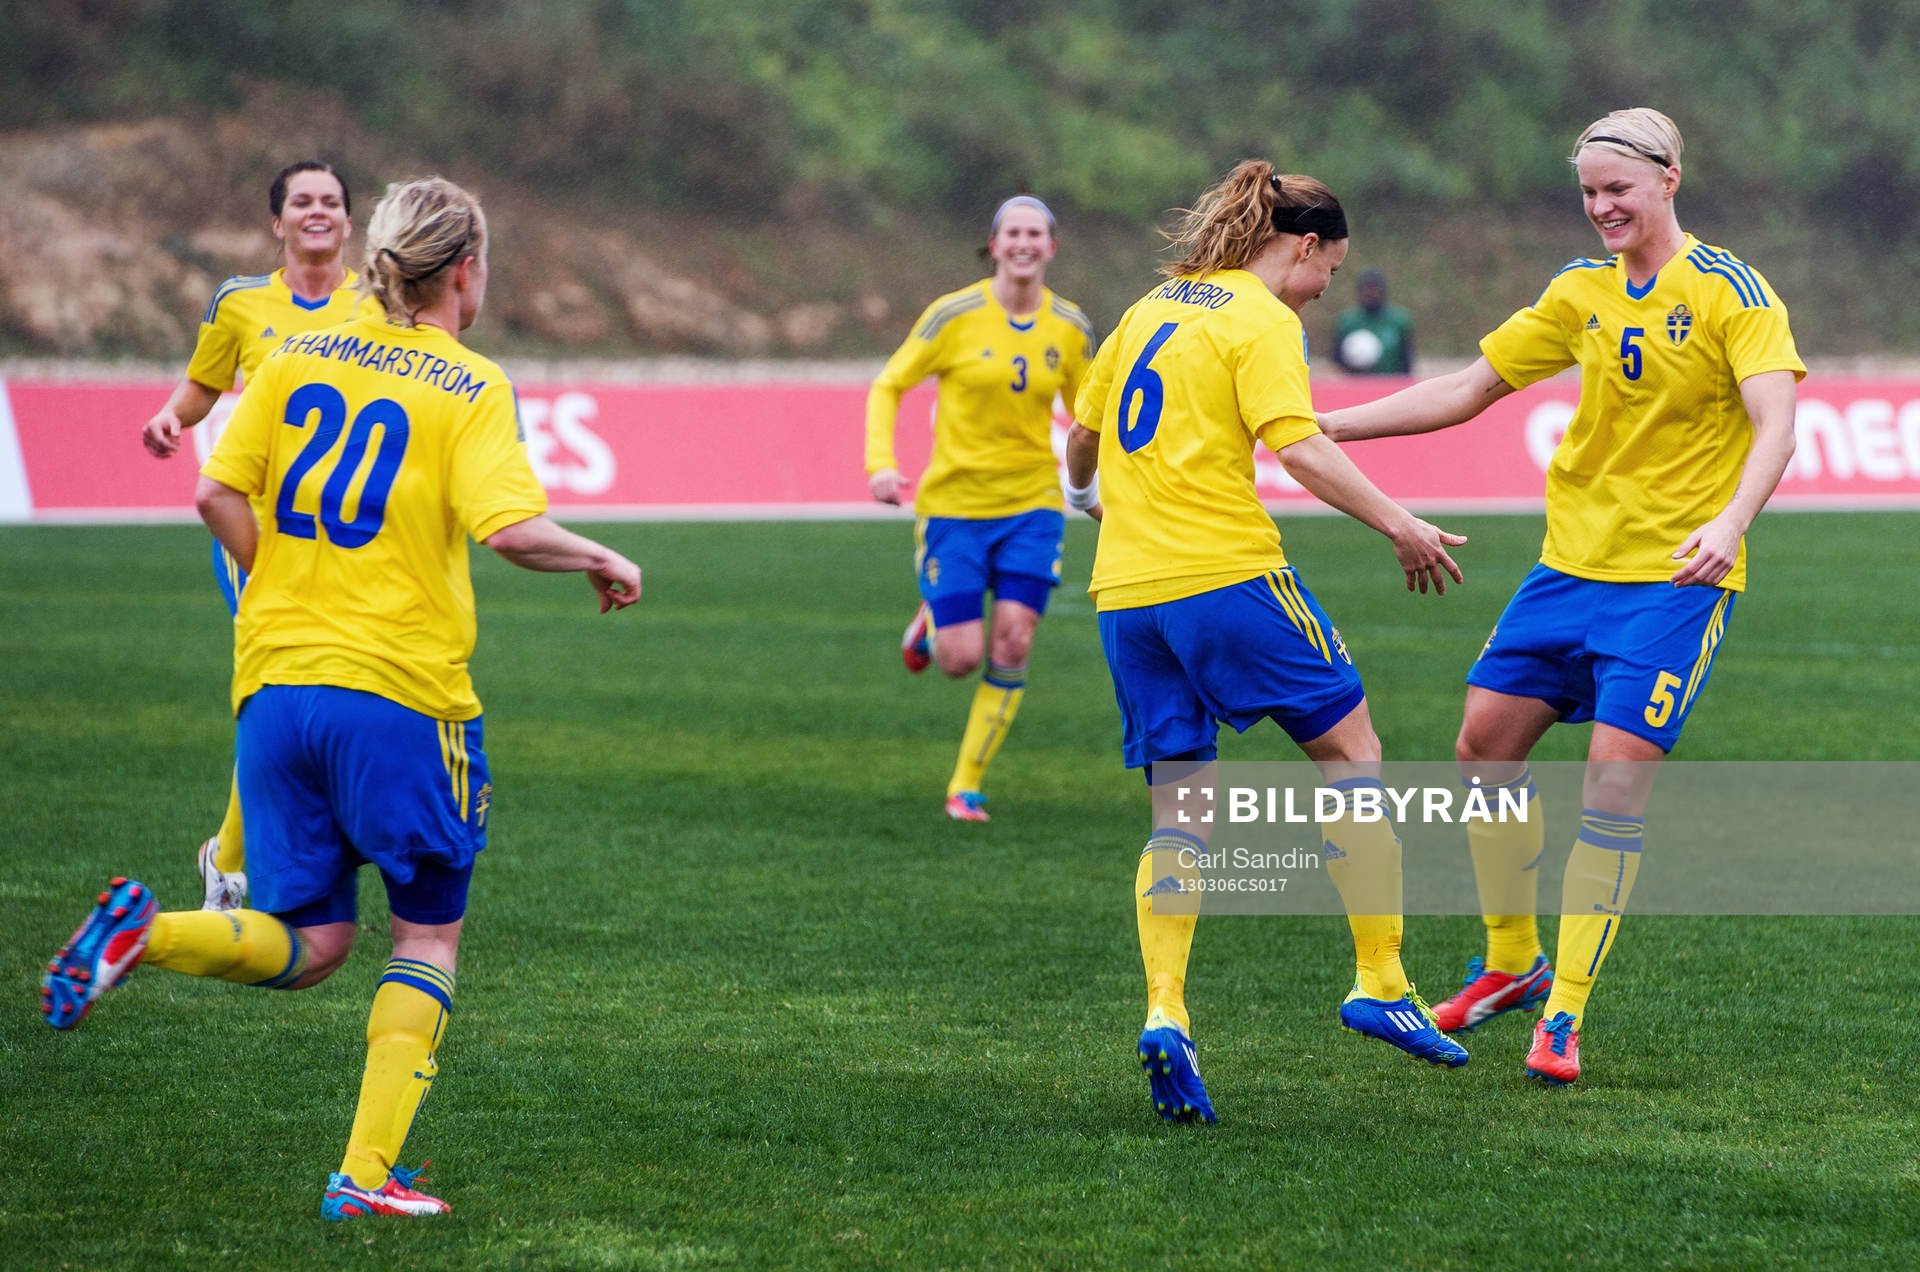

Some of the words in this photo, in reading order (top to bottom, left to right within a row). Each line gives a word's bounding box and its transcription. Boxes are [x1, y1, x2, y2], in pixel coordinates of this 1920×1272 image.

[1011, 356, 1026, 392] 3
[1620, 327, 1644, 380] 5
[1118, 322, 1179, 454] 6
[276, 383, 410, 549] 20
[1644, 670, 1681, 728] 5
